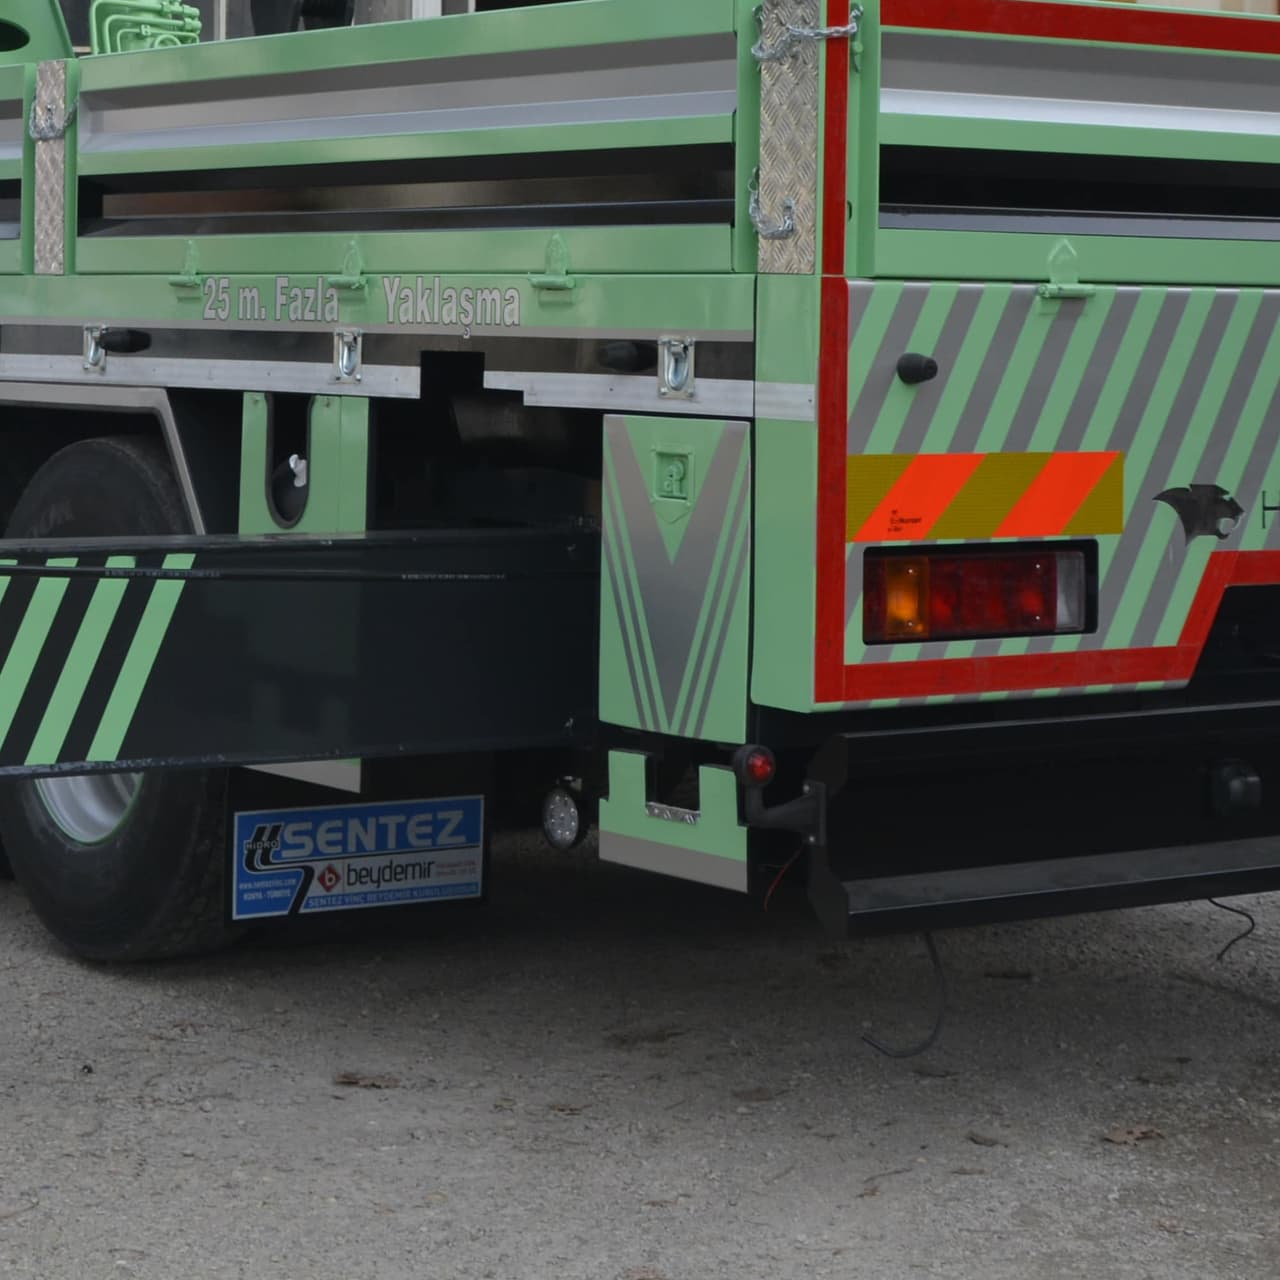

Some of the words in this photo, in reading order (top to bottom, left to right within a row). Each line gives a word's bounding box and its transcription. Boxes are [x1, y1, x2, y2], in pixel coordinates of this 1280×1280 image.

[202, 277, 231, 321] 25
[238, 285, 266, 320] m.
[275, 276, 340, 322] Fazla
[382, 276, 521, 339] Yaklaşma
[281, 810, 467, 858] SENTEZ
[347, 860, 436, 888] beydemir
